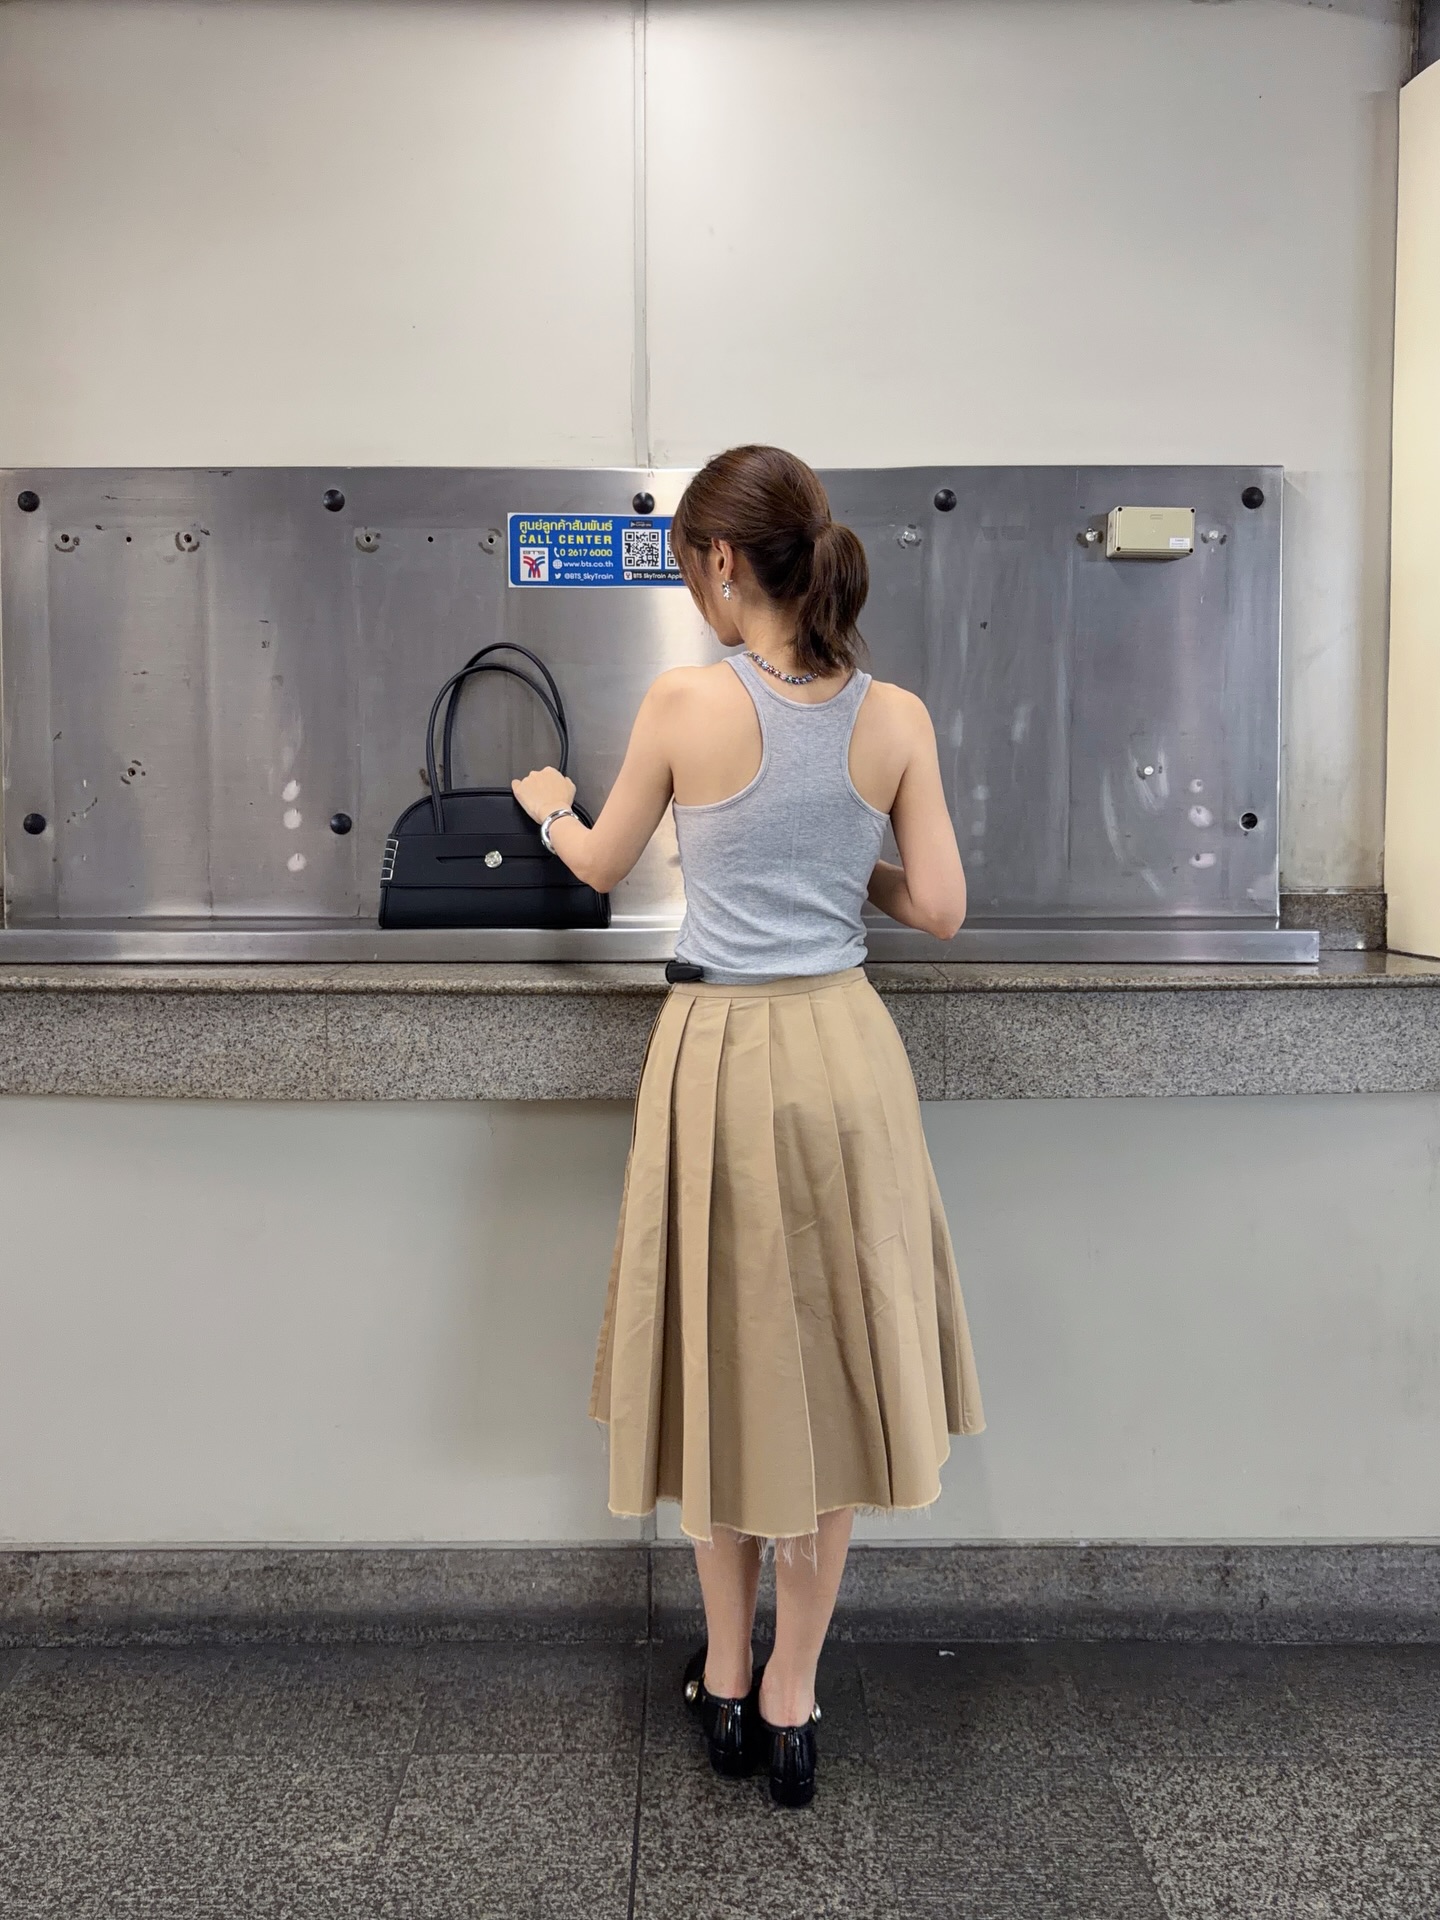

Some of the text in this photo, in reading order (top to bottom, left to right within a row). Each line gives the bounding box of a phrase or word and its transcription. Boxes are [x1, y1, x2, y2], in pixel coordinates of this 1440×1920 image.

[519, 518, 613, 534] ศูนย์ลูกค้าสัมพันธ์
[519, 534, 613, 544] CALL CENTER
[560, 548, 613, 558] 0 2617 6000
[564, 572, 614, 581] @BTS_SkyTrain
